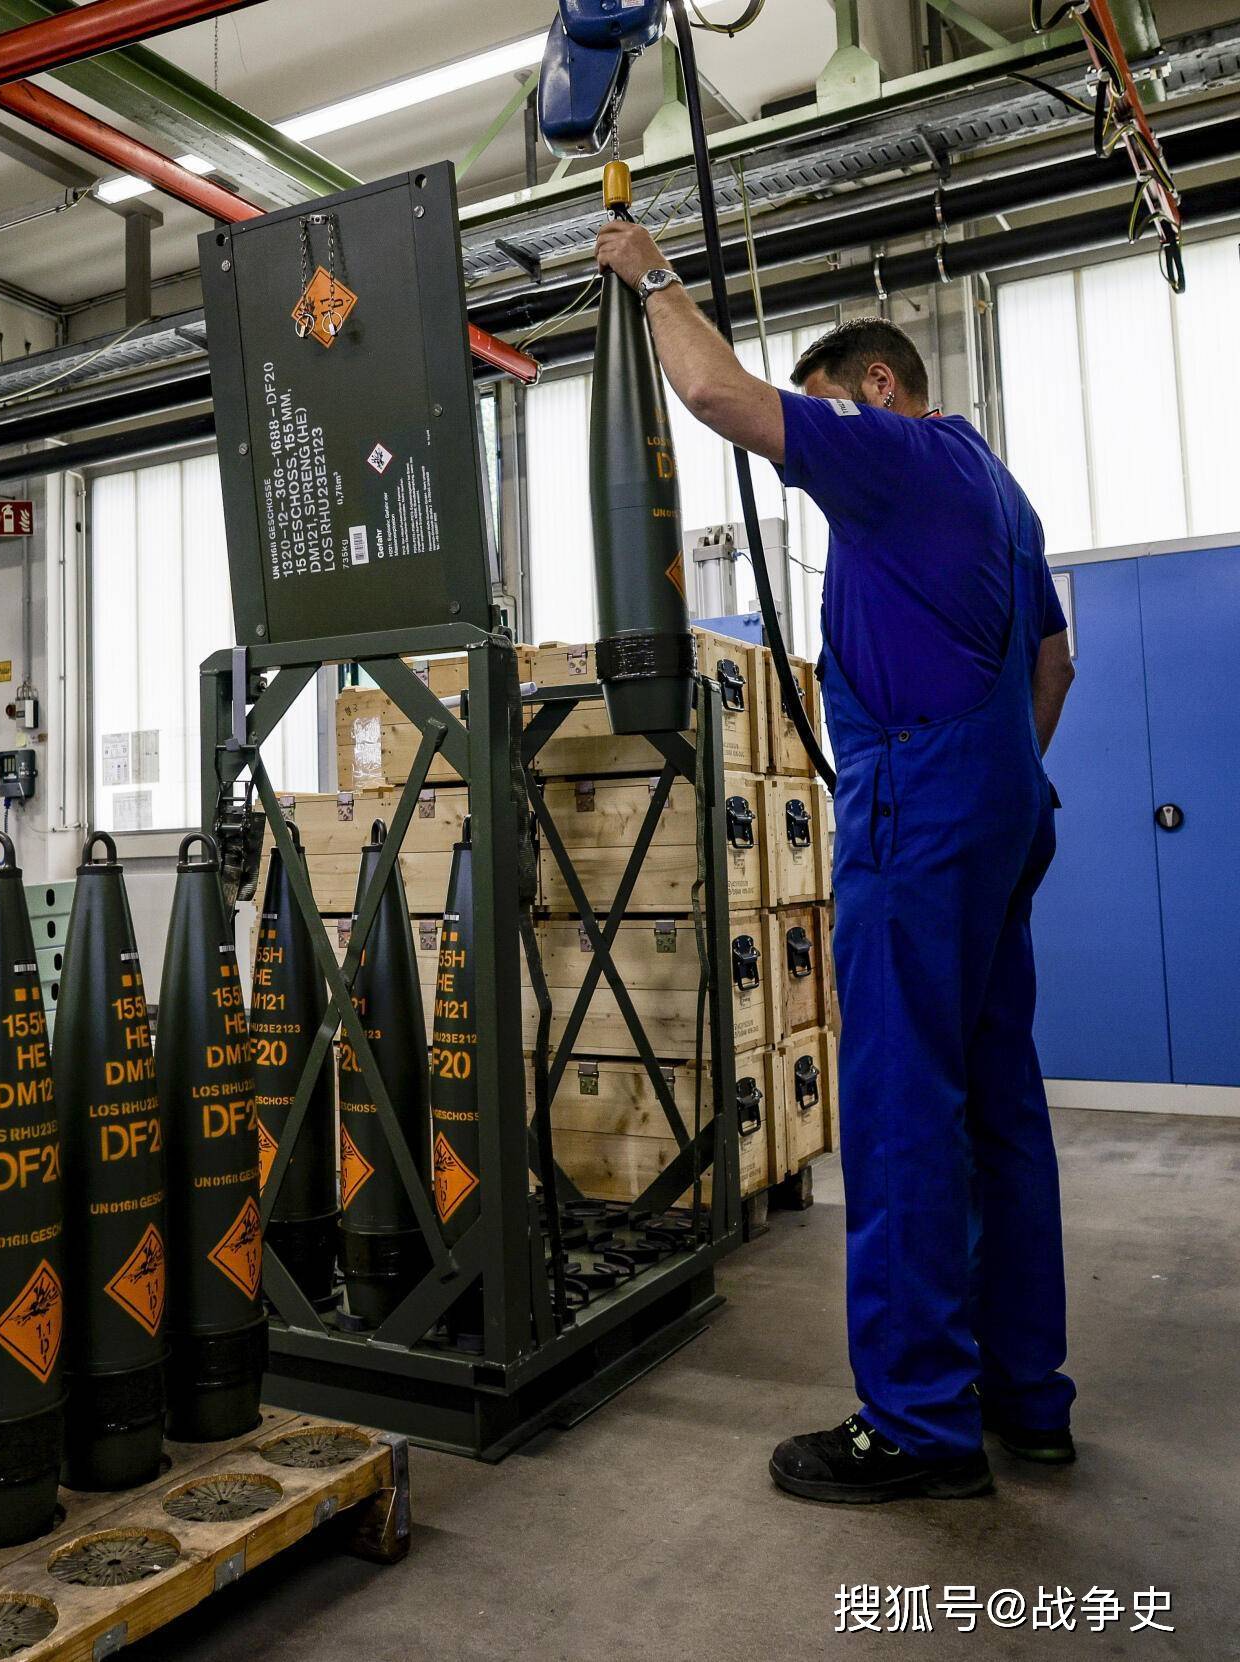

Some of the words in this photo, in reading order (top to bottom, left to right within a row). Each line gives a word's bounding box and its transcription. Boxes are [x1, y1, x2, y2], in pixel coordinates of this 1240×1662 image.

[283, 423, 296, 451] 155
[294, 407, 310, 443] (HE)
[298, 445, 316, 516] SPRENG
[264, 478, 276, 539] GESCHOSSE
[321, 536, 336, 571] LOS
[376, 528, 385, 559] Gefahr
[272, 565, 280, 579] UN
[295, 558, 307, 575] 15
[224, 1012, 247, 1035] HE
[125, 1025, 150, 1050] HE
[17, 1043, 47, 1071] HE
[192, 1084, 220, 1098] LOS
[89, 1103, 120, 1118] LOS
[194, 1176, 211, 1188] UN
[90, 1203, 109, 1215] UN
